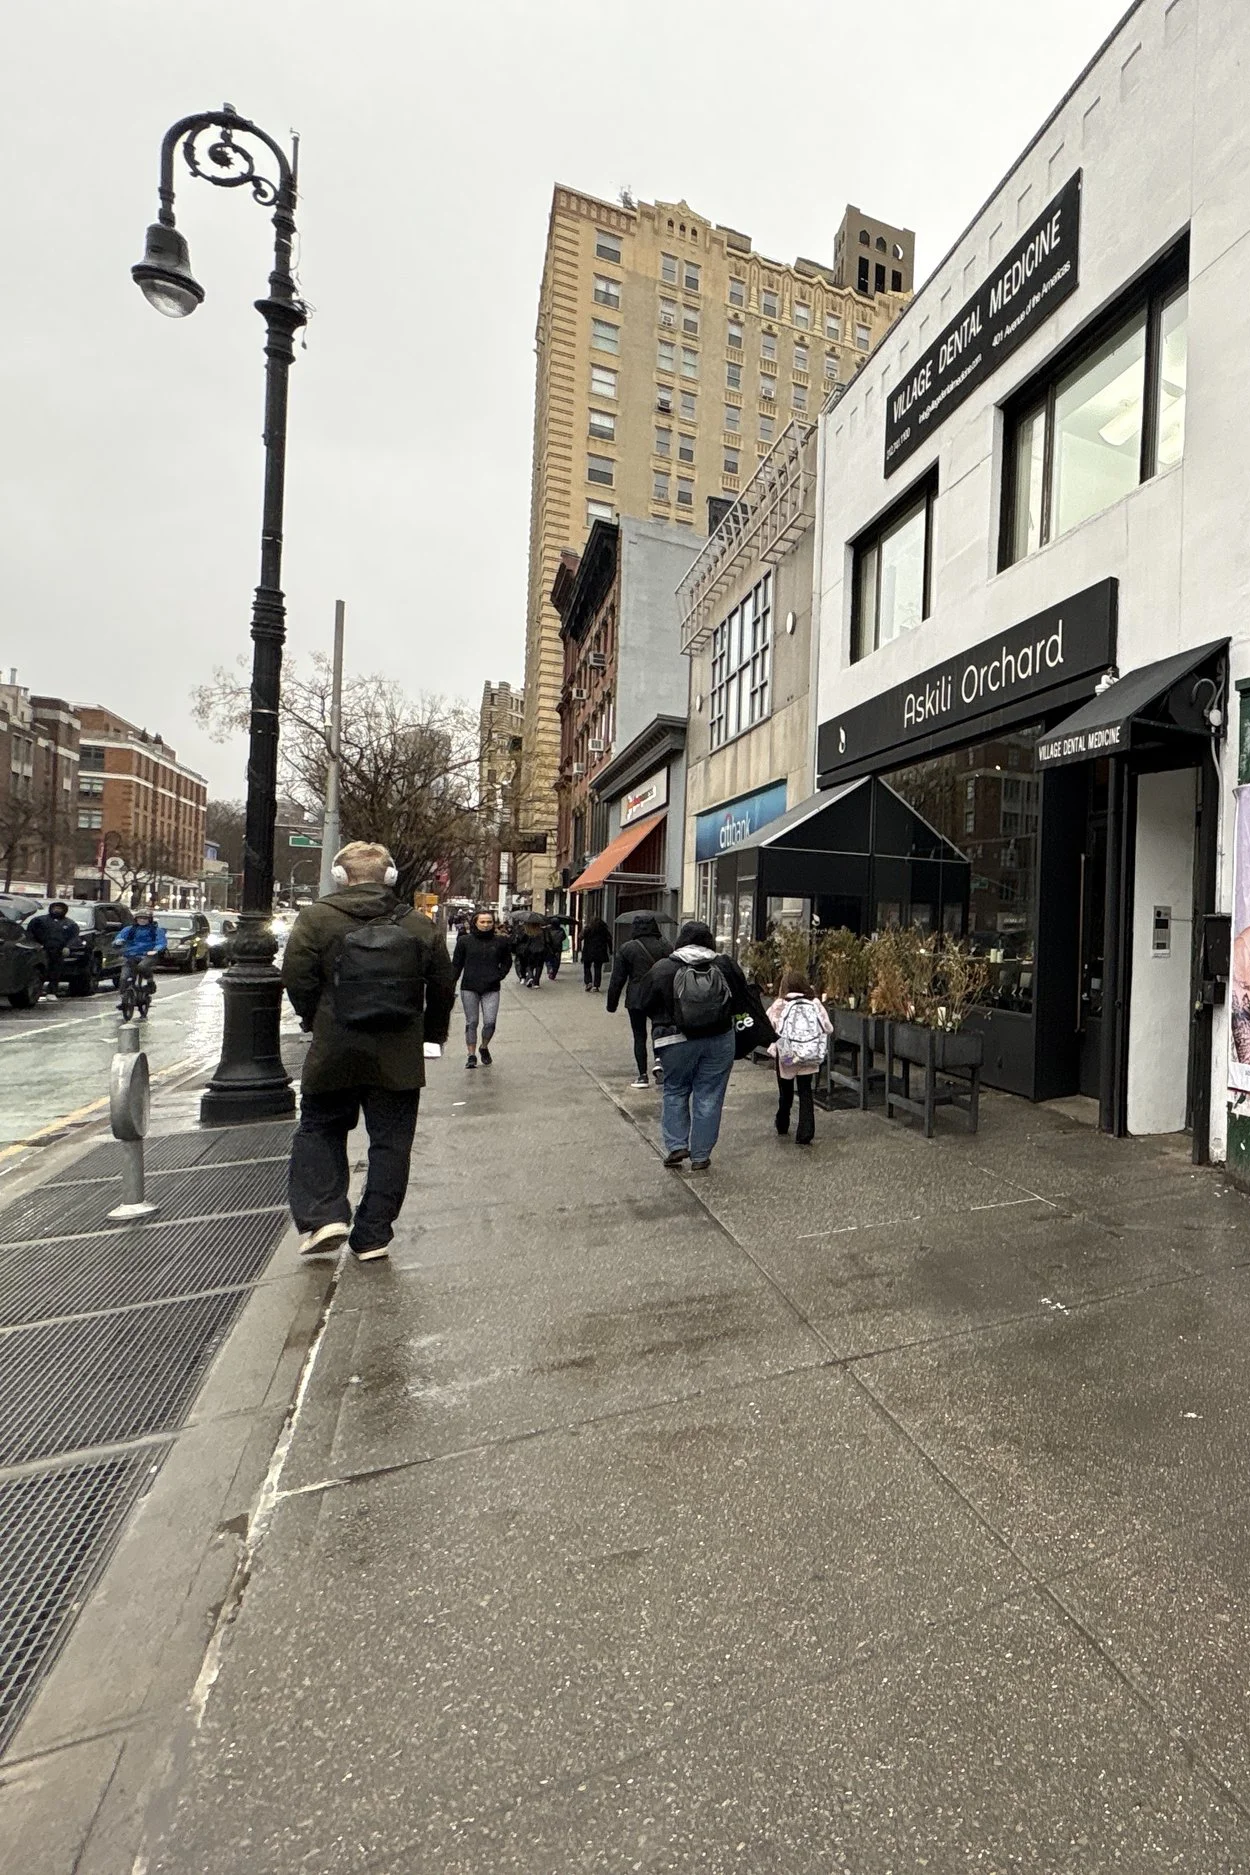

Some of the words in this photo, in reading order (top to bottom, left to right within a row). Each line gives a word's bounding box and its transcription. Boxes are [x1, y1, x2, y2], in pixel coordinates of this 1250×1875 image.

[893, 359, 933, 424] VILLAGE
[938, 305, 983, 375] DENTAL
[989, 208, 1062, 318] MEDICINE
[992, 330, 1003, 346] 401
[1004, 311, 1026, 338] Avenue
[1025, 299, 1032, 315] of
[1032, 292, 1041, 308] the
[1041, 260, 1071, 298] Americas
[904, 675, 951, 729] Askili
[961, 619, 1064, 703] Orchard
[1038, 741, 1062, 761] VILLAGE
[1063, 735, 1086, 756] DENTAL
[1087, 725, 1121, 750] MEDICINE
[719, 810, 751, 849] citibank
